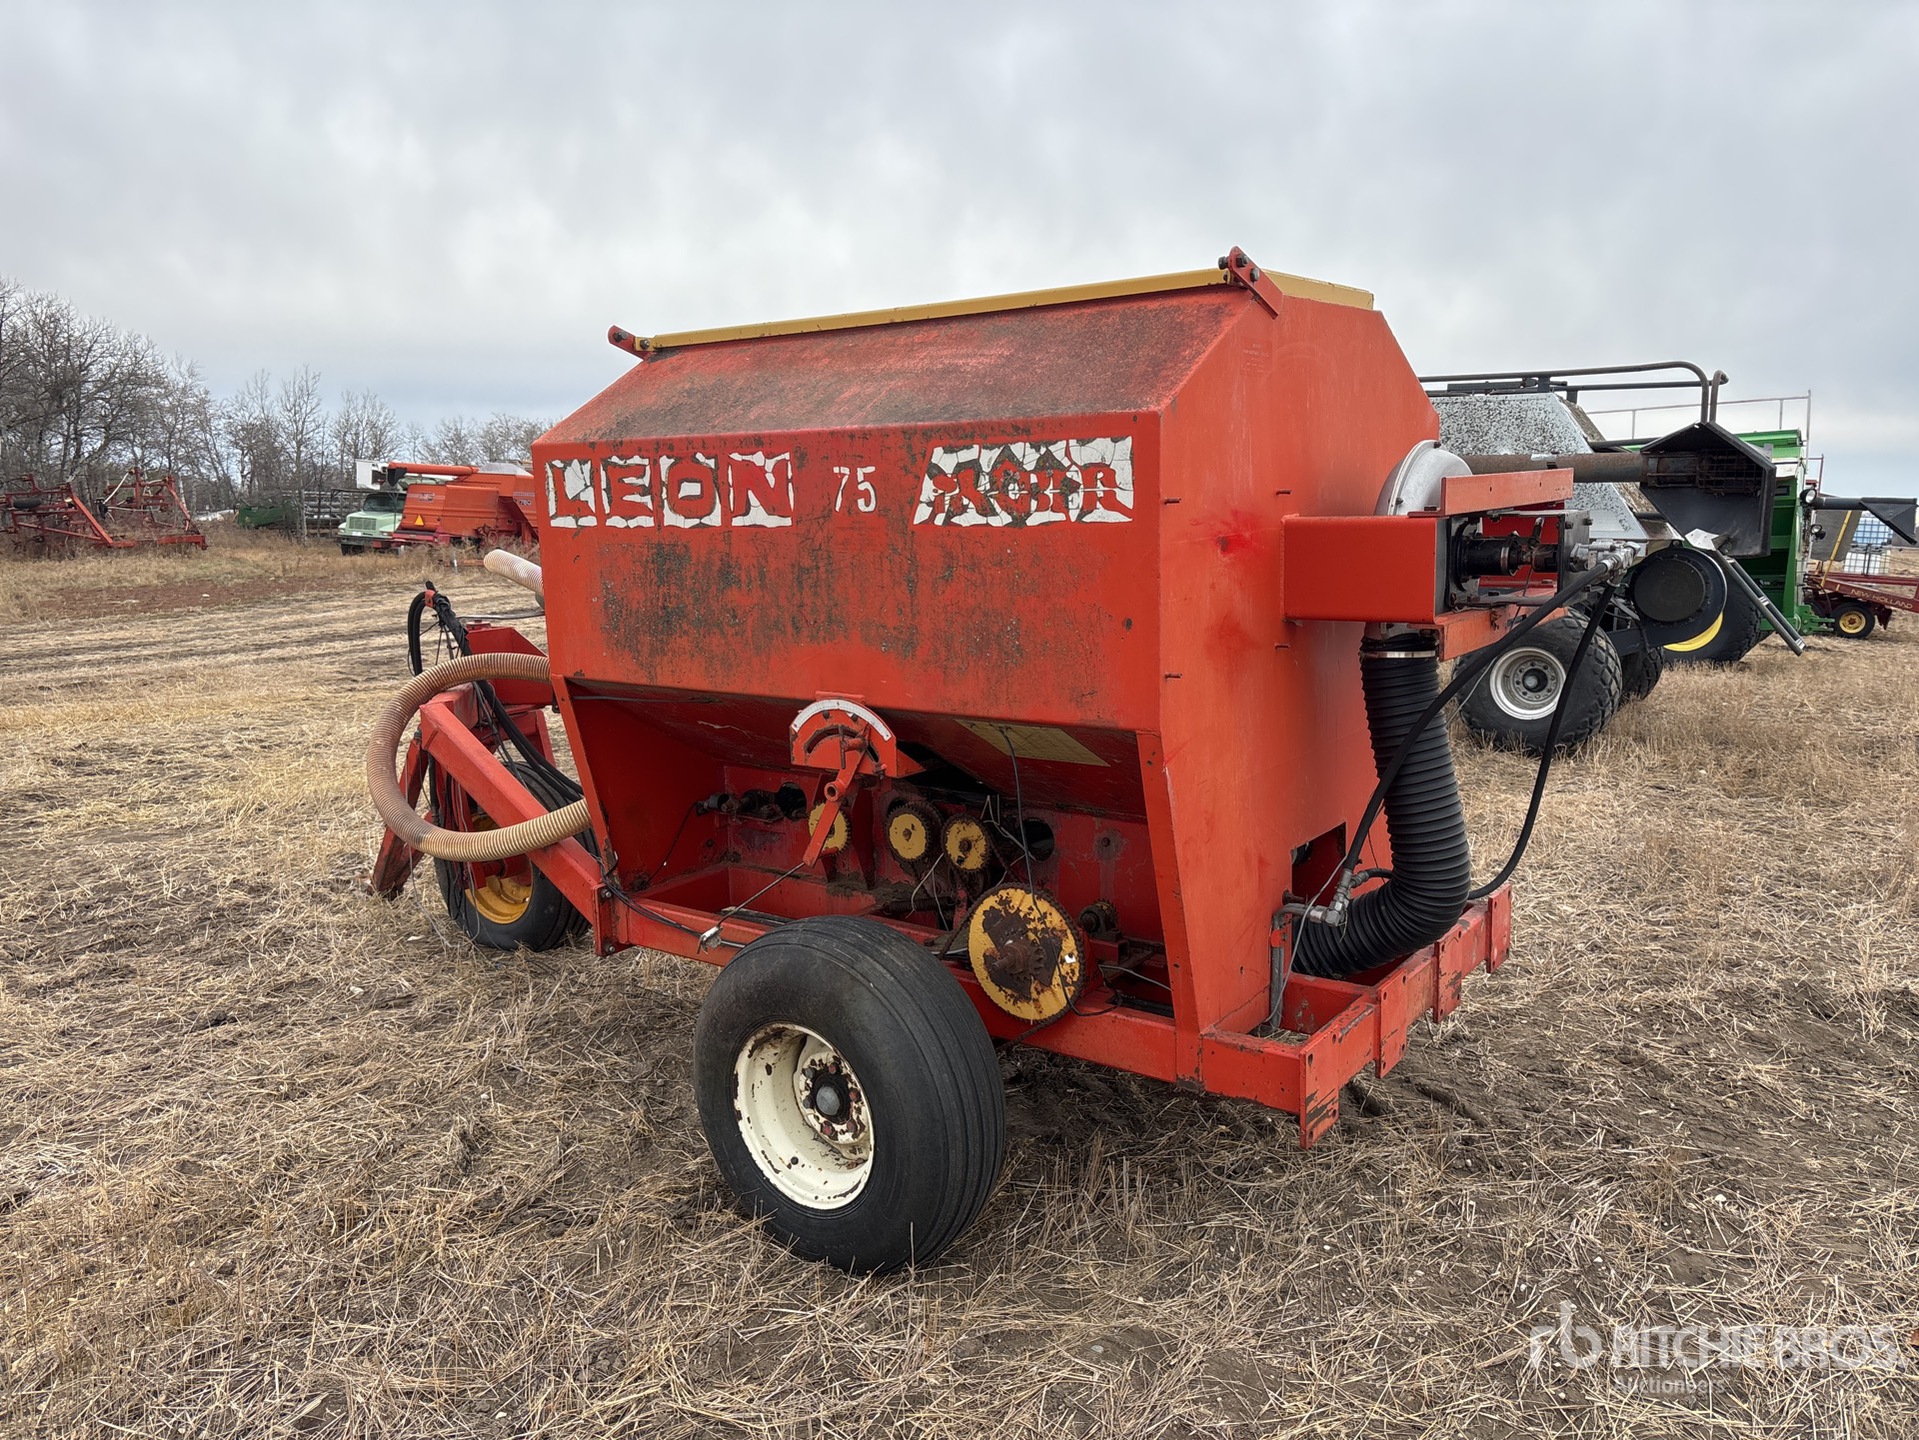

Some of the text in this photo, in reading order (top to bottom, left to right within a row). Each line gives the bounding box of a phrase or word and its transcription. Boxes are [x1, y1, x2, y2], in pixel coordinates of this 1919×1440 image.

[545, 451, 795, 528] LEON
[833, 465, 877, 512] 75
[1850, 589, 1913, 609] NEW HOLLAND
